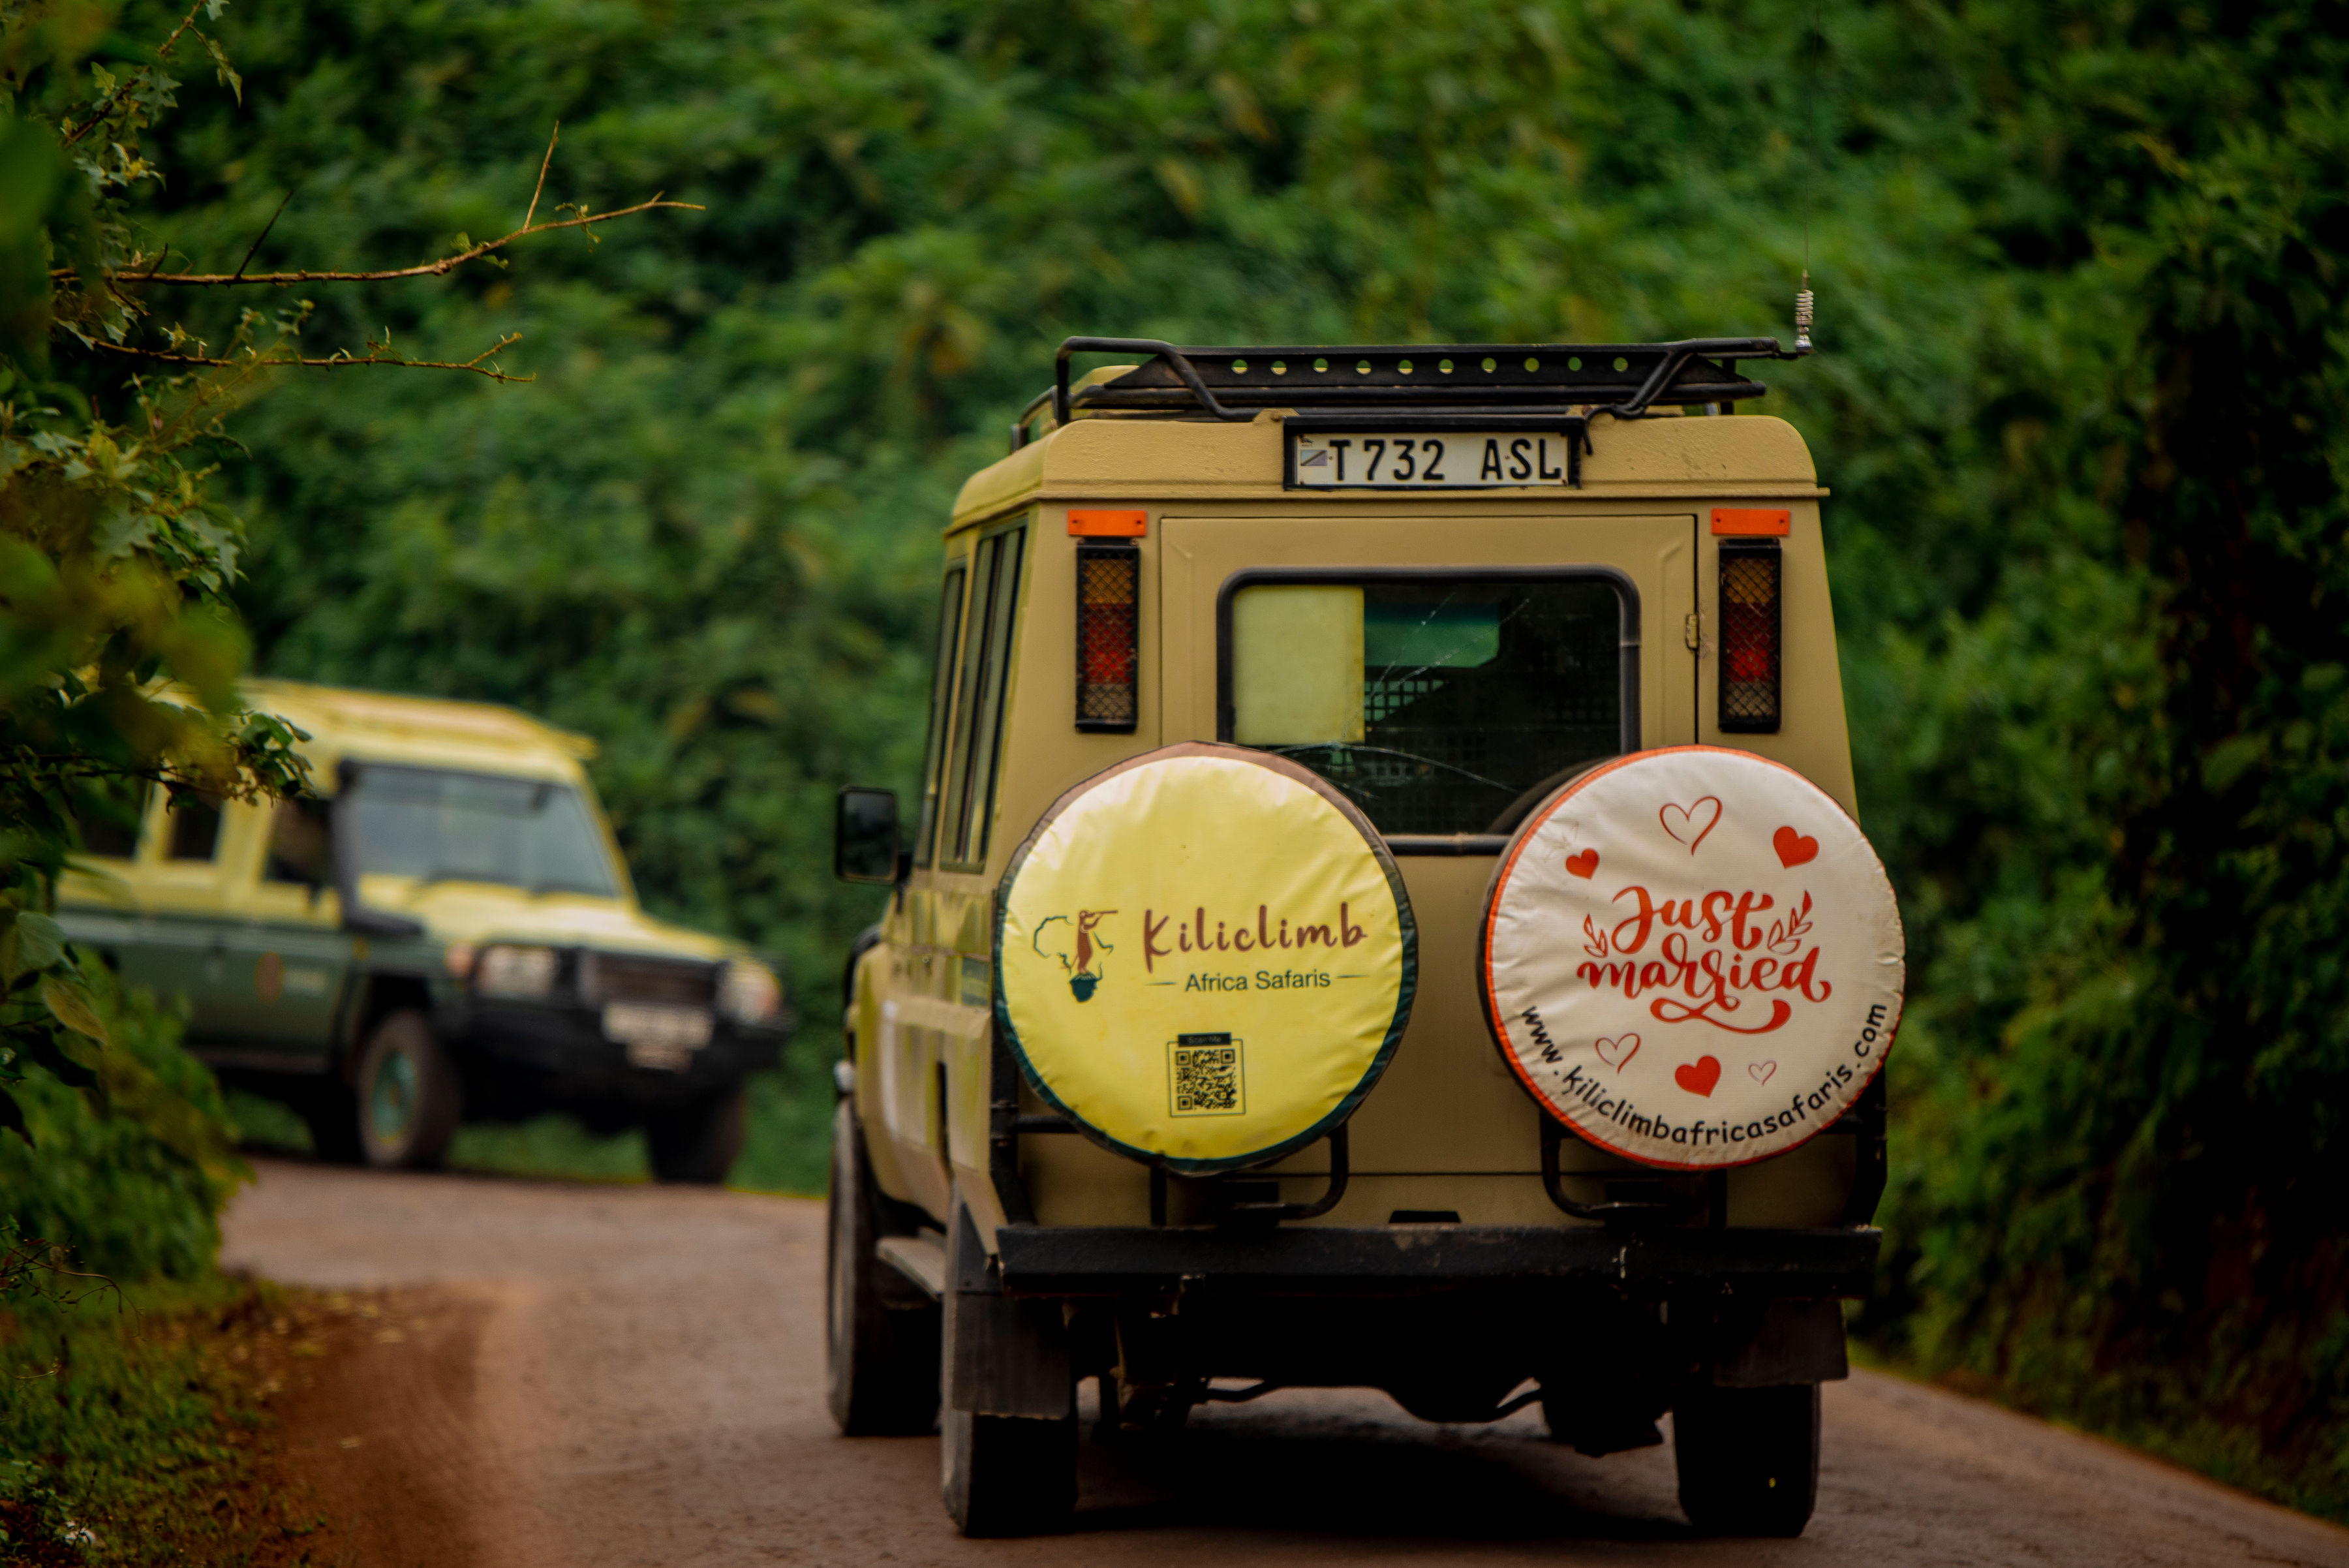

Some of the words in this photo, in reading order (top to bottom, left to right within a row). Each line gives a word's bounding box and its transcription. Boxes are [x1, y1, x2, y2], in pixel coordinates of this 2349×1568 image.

[1481, 438, 1562, 481] ASL
[1143, 901, 1368, 974] Kiliclimb
[1611, 885, 1774, 955] Just
[1185, 972, 1249, 992] Africa
[1255, 969, 1331, 989] Safaris
[1576, 932, 1832, 1013] married
